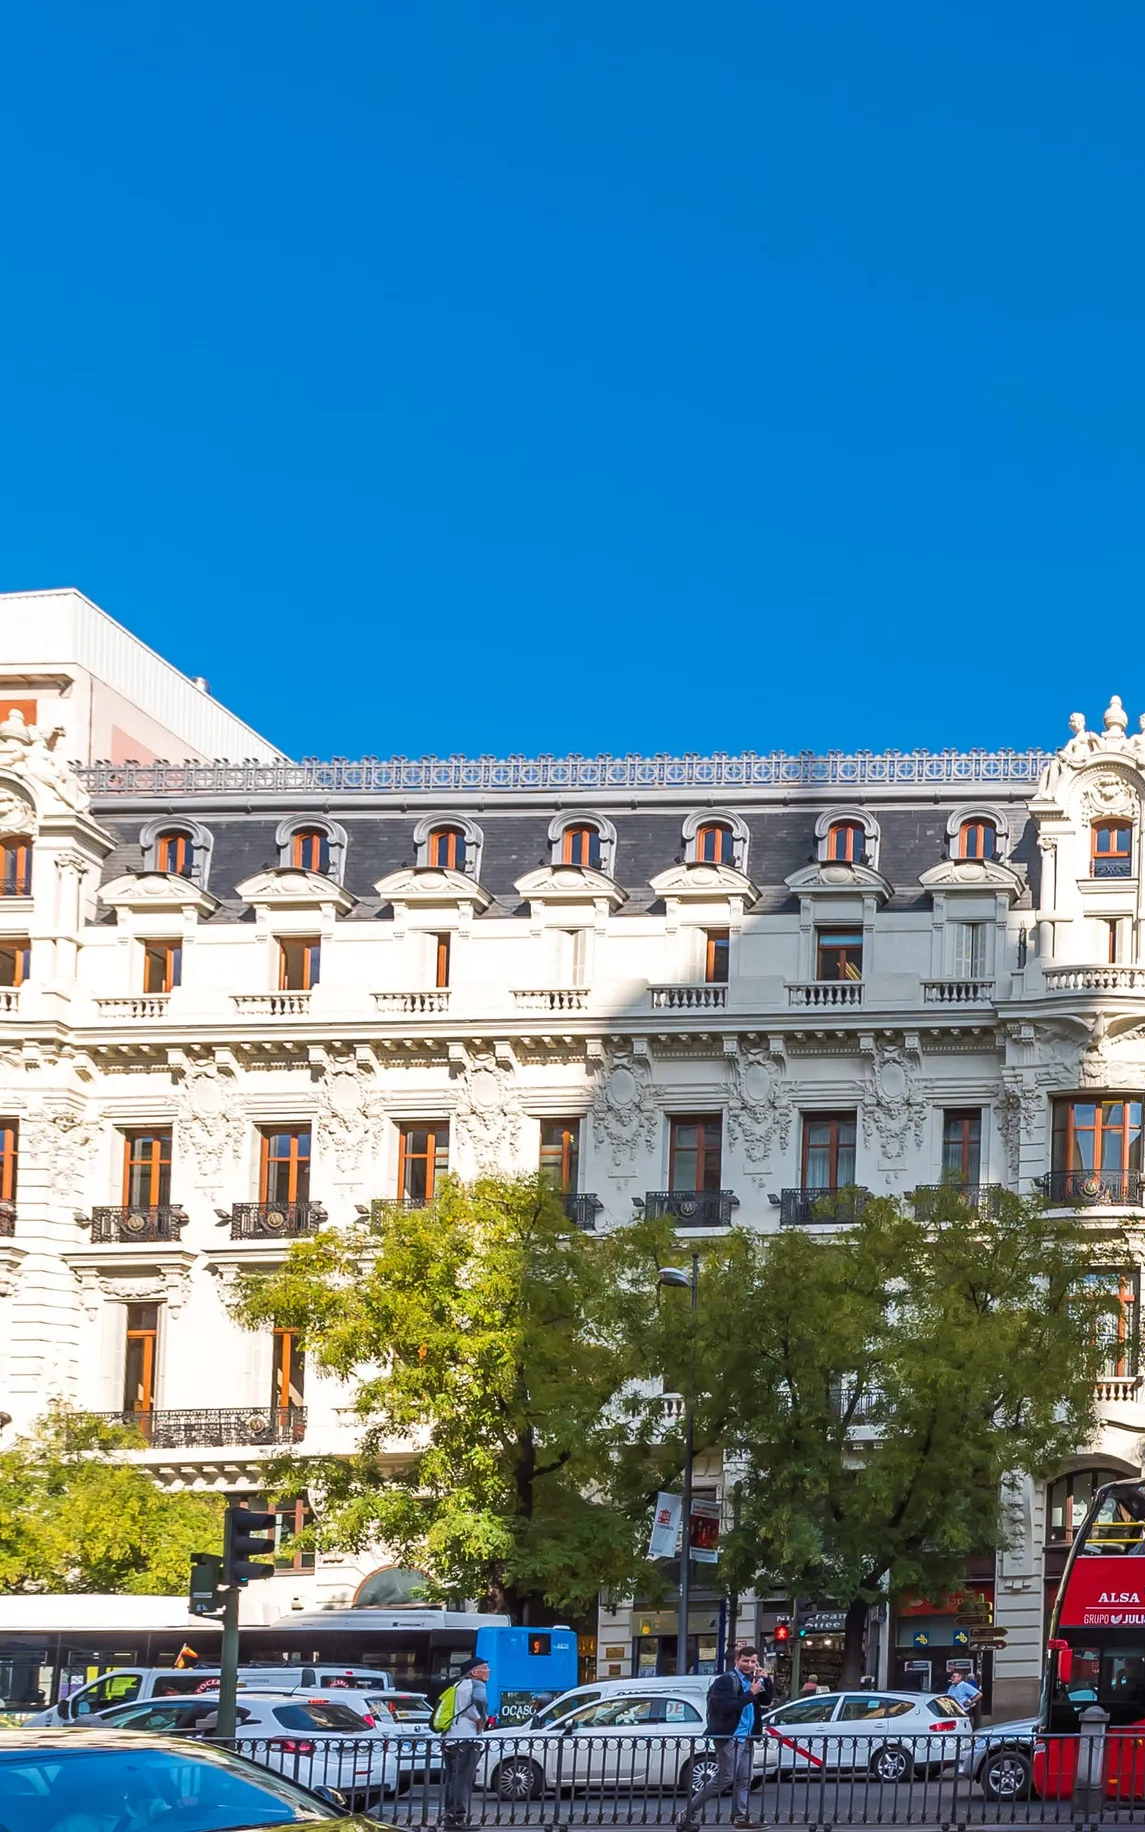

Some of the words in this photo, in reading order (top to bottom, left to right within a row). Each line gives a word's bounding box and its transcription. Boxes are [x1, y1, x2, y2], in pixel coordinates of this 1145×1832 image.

[1098, 1592, 1140, 1603] ALSA
[1083, 1613, 1110, 1625] GRUPO
[533, 1641, 541, 1654] 9
